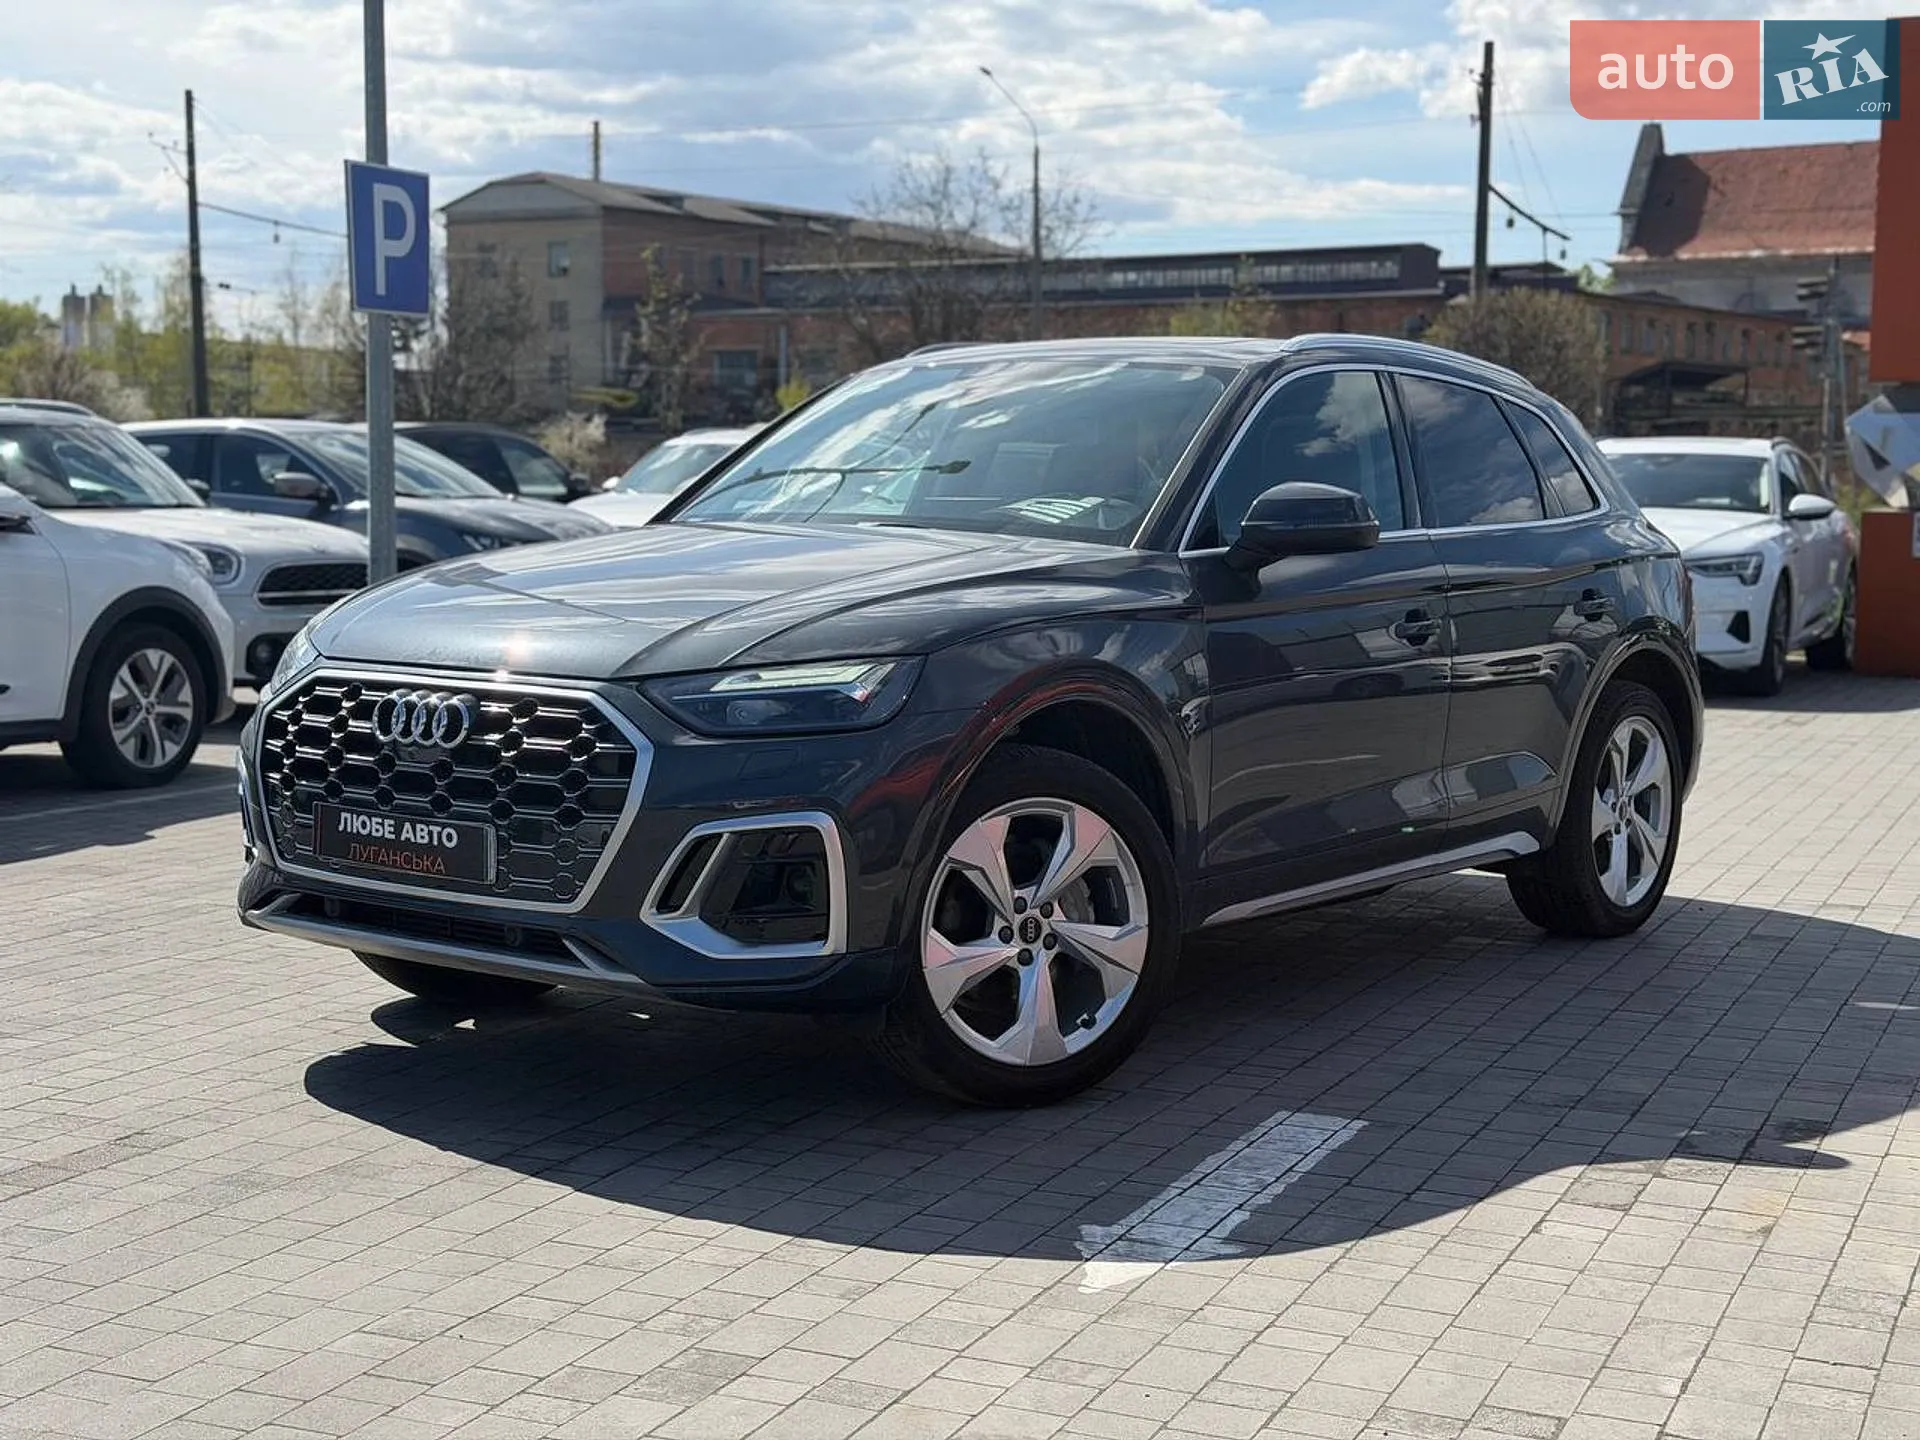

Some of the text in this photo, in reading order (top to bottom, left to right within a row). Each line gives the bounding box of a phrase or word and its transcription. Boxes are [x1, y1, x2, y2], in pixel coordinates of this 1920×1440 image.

[372, 182, 416, 296] P
[338, 811, 459, 849] ЛЮБЕ АВТО
[349, 842, 446, 874] ЛУГАНСЬКА
